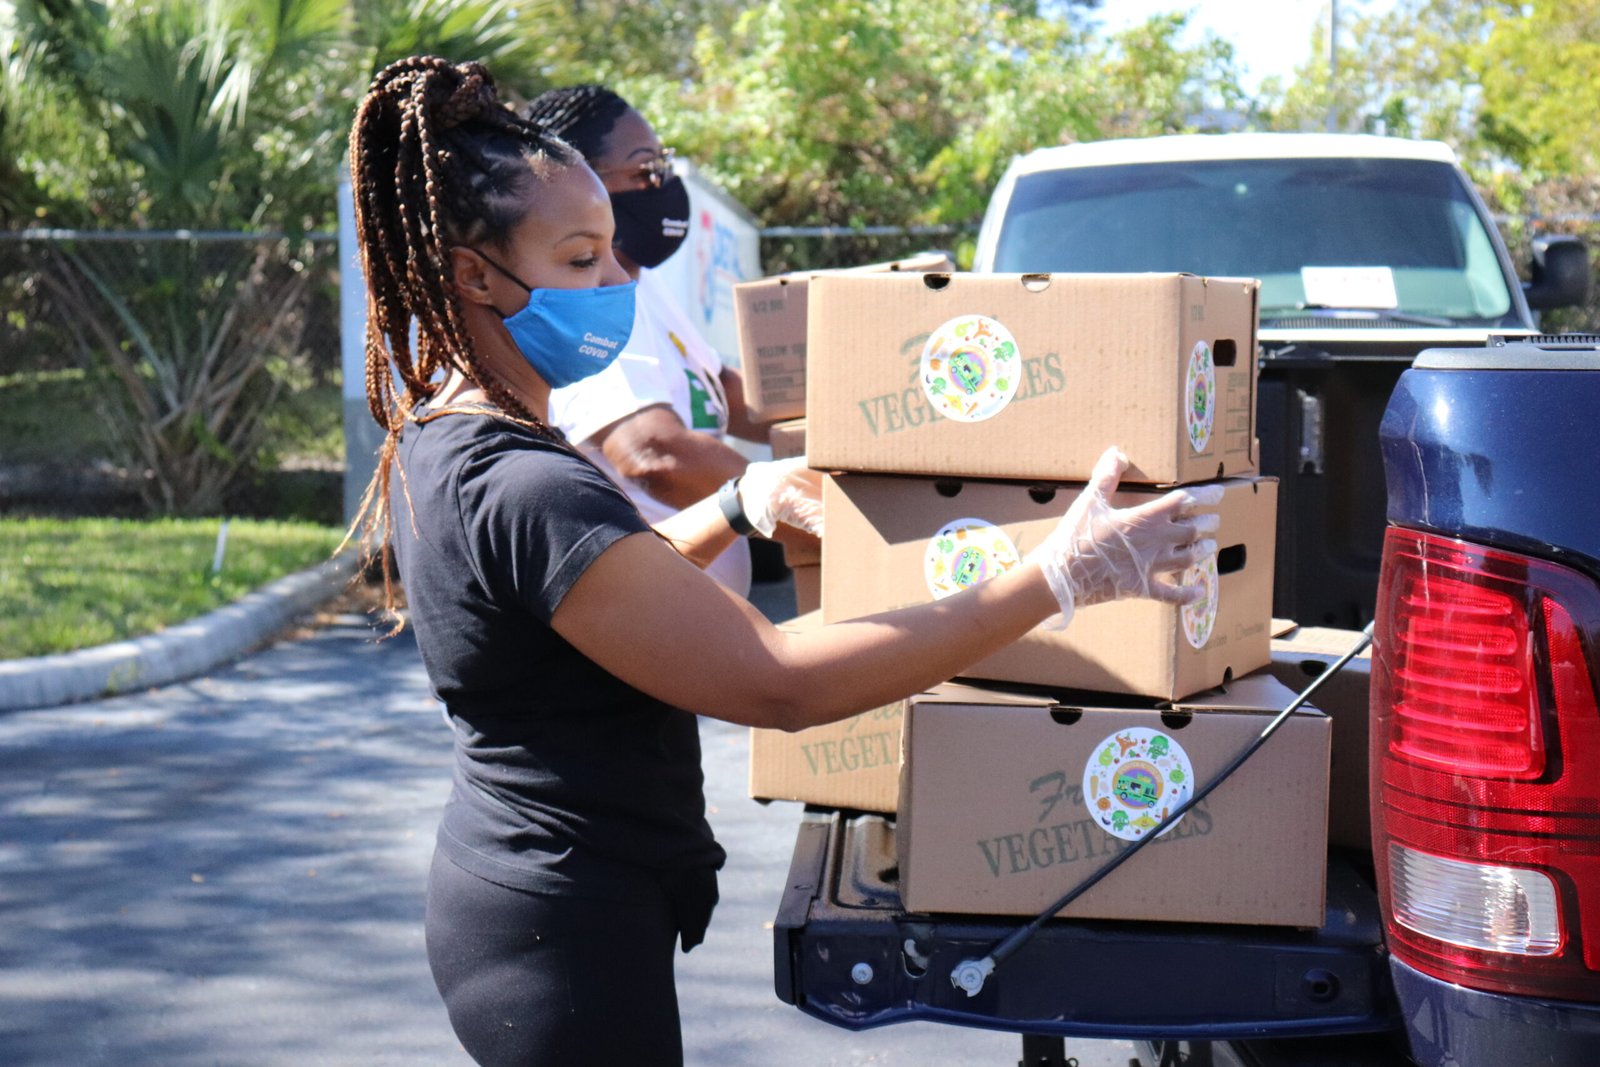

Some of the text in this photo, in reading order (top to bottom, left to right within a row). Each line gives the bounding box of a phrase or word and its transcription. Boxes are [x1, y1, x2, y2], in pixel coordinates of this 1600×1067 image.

[583, 331, 619, 350] Combat
[578, 344, 609, 359] COVID
[801, 729, 901, 776] VEGET
